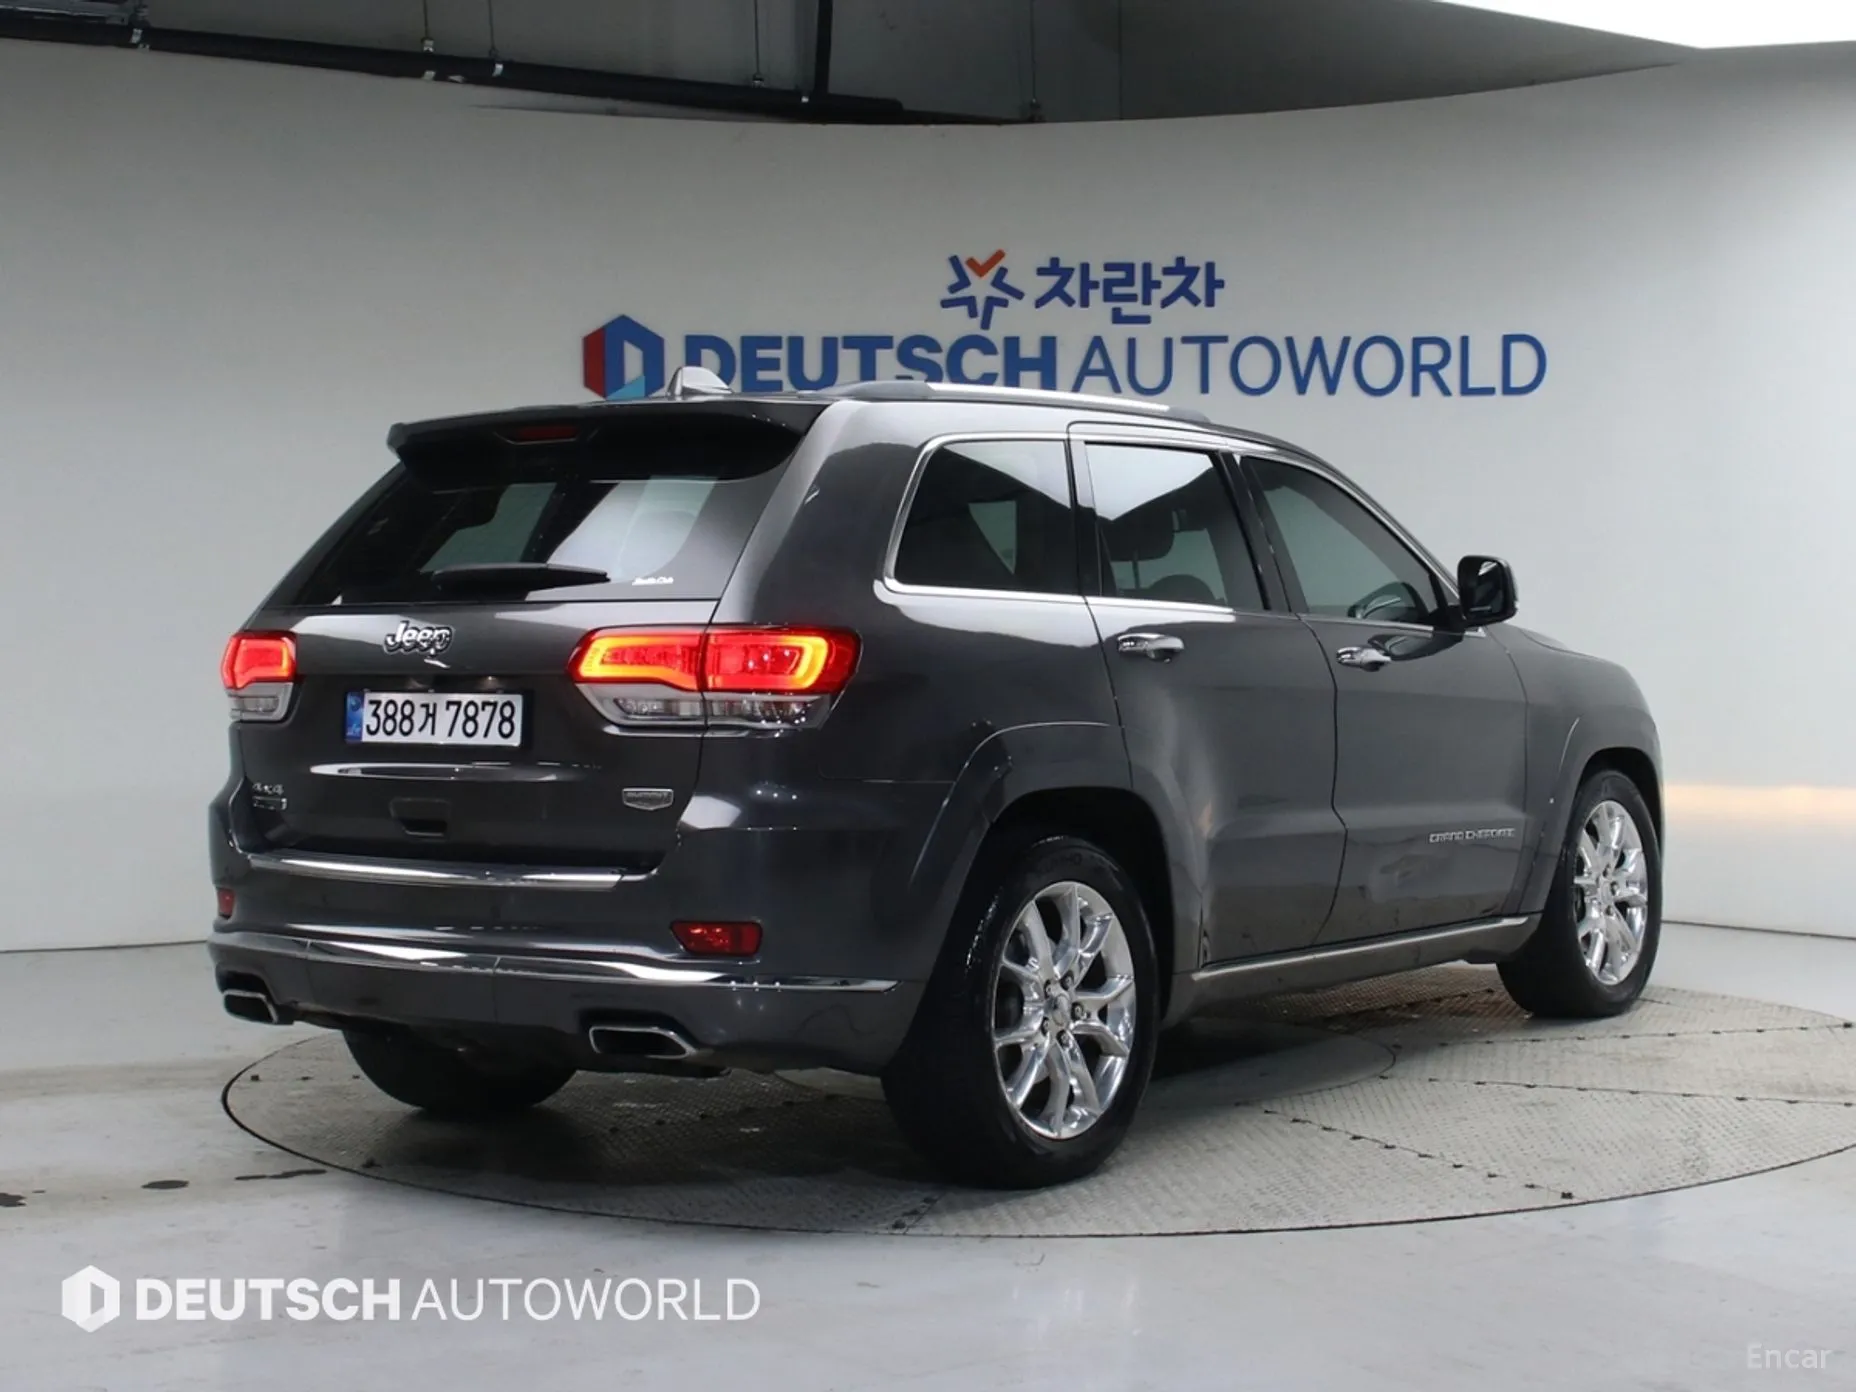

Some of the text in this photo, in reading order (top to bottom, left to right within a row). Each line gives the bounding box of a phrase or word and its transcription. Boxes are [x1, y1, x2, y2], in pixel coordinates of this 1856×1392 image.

[1036, 257, 1225, 324] 차란차
[684, 333, 1548, 397] DEUTSCH AUTOWORLD
[384, 621, 453, 657] Jeep
[445, 700, 516, 739] 7878
